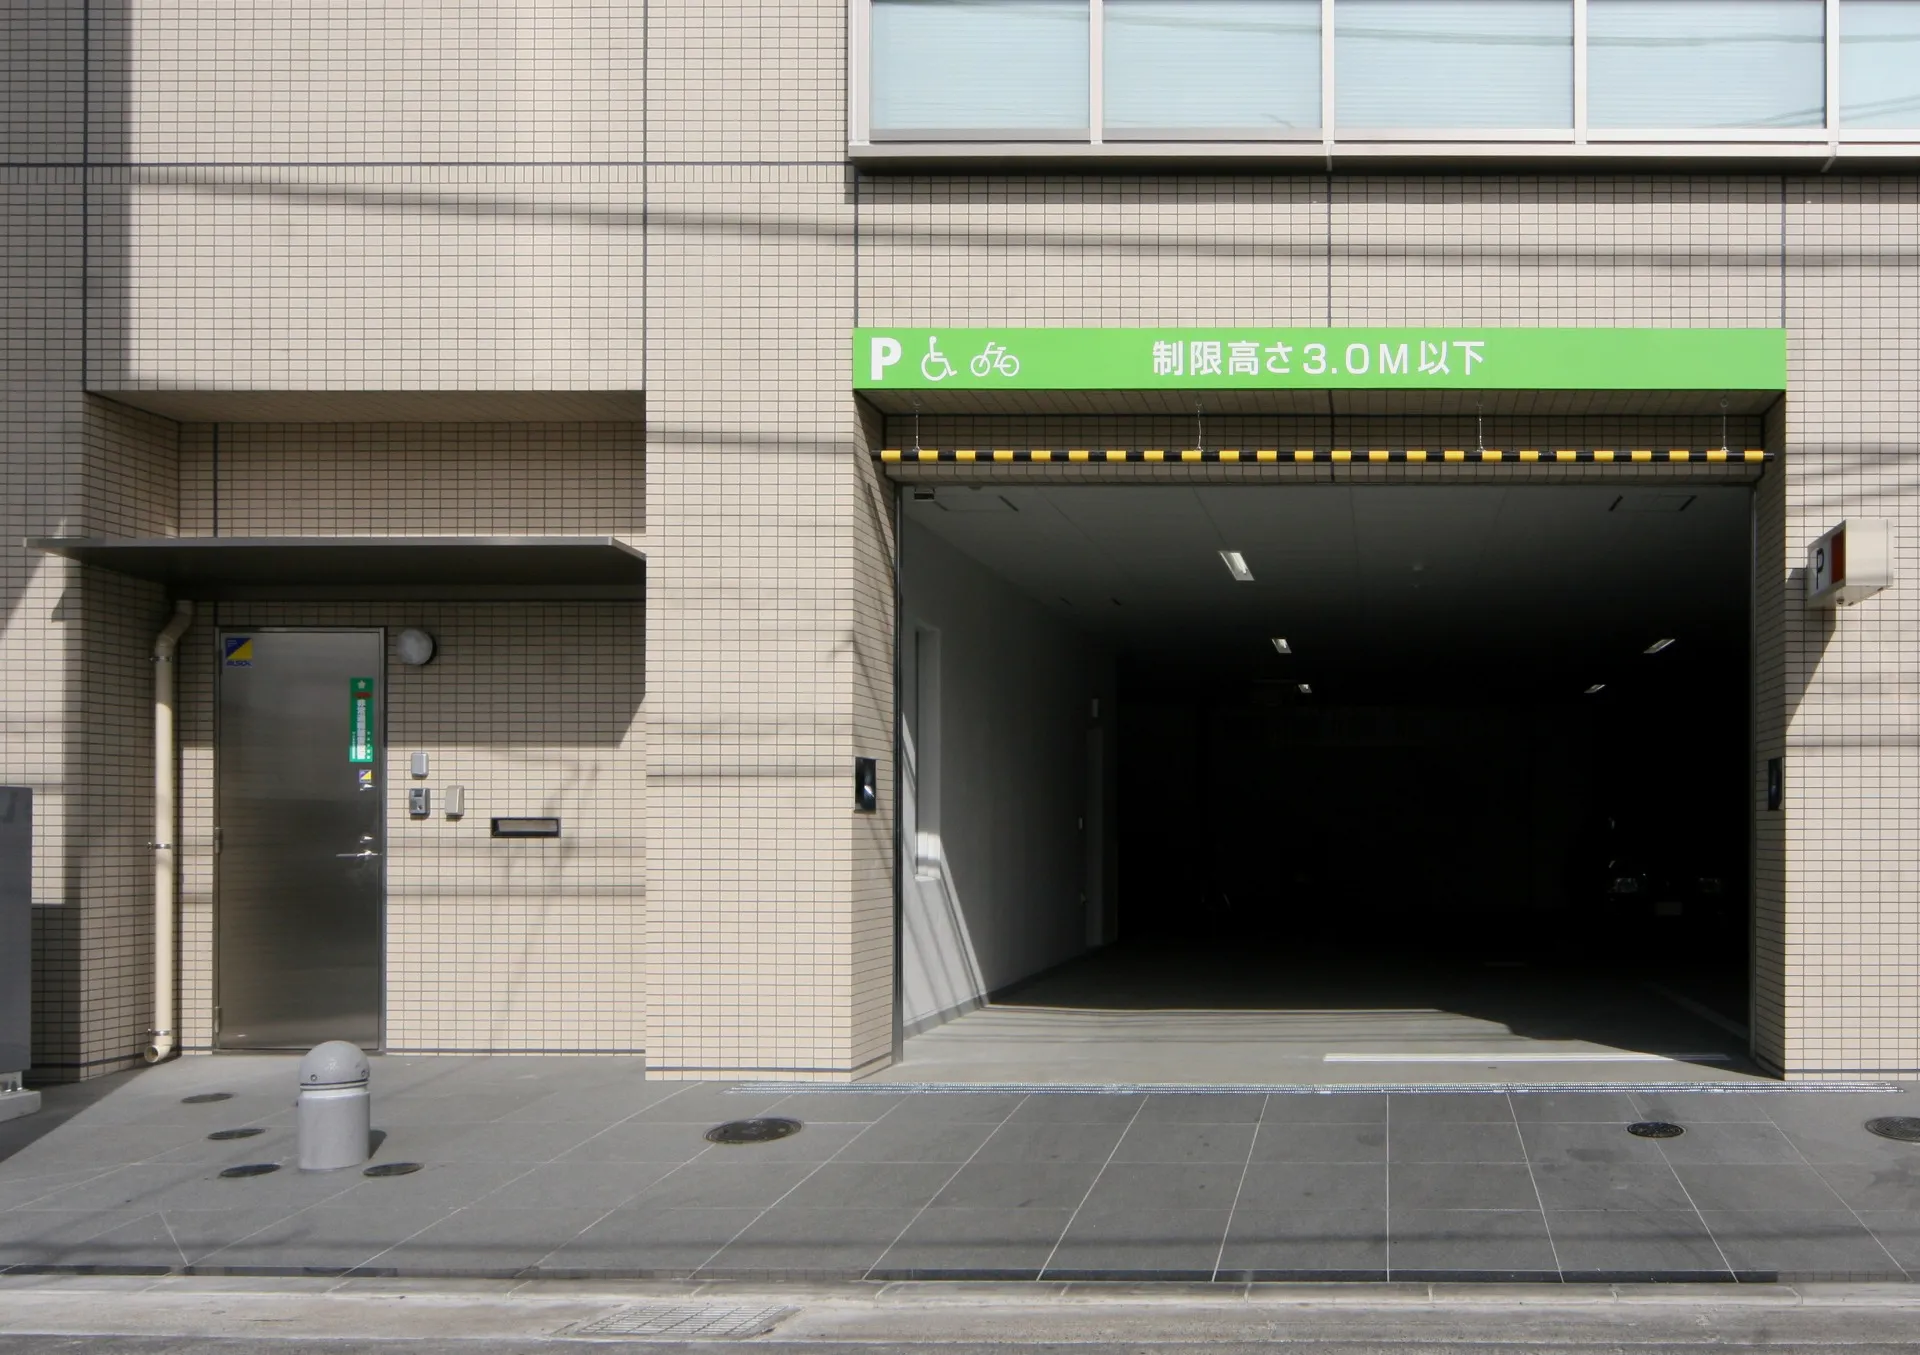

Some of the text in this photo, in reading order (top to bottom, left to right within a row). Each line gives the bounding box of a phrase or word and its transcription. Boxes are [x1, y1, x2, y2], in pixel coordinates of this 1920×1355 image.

[870, 336, 903, 381] P
[1152, 339, 1486, 377] 制限高さ3.0M以下
[1816, 547, 1825, 590] P
